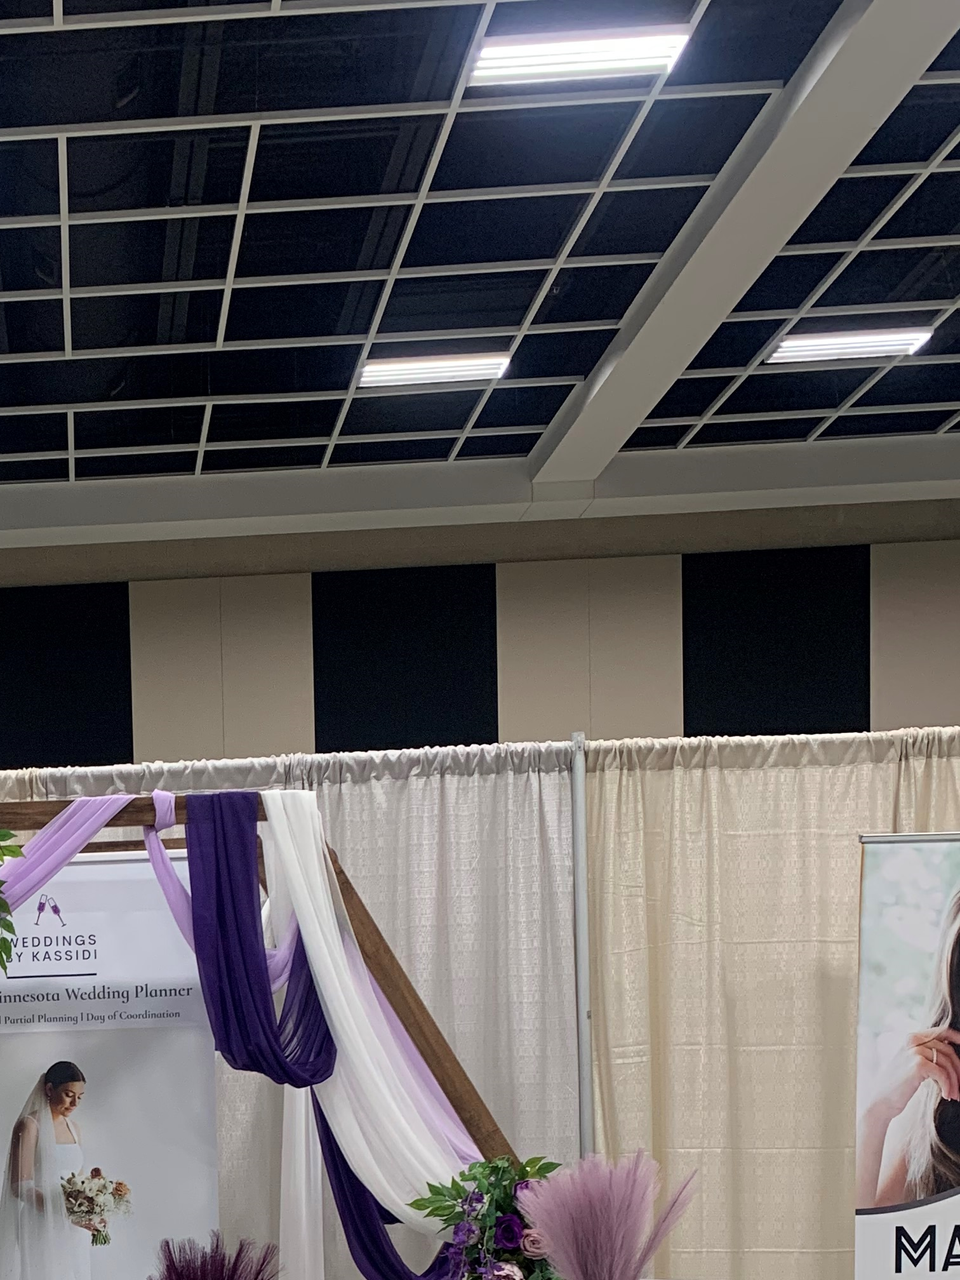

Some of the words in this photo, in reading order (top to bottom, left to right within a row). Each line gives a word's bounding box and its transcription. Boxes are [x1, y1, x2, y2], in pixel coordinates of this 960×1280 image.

[9, 934, 97, 949] WEDDINGS
[32, 949, 97, 962] KASSIDI
[65, 985, 130, 1005] Wedding
[134, 984, 193, 999] Planner
[4, 1014, 35, 1025] Partial
[38, 1014, 78, 1026] Planning
[86, 1012, 105, 1024] Day
[108, 1010, 118, 1021] of
[119, 1010, 181, 1021] Coordination
